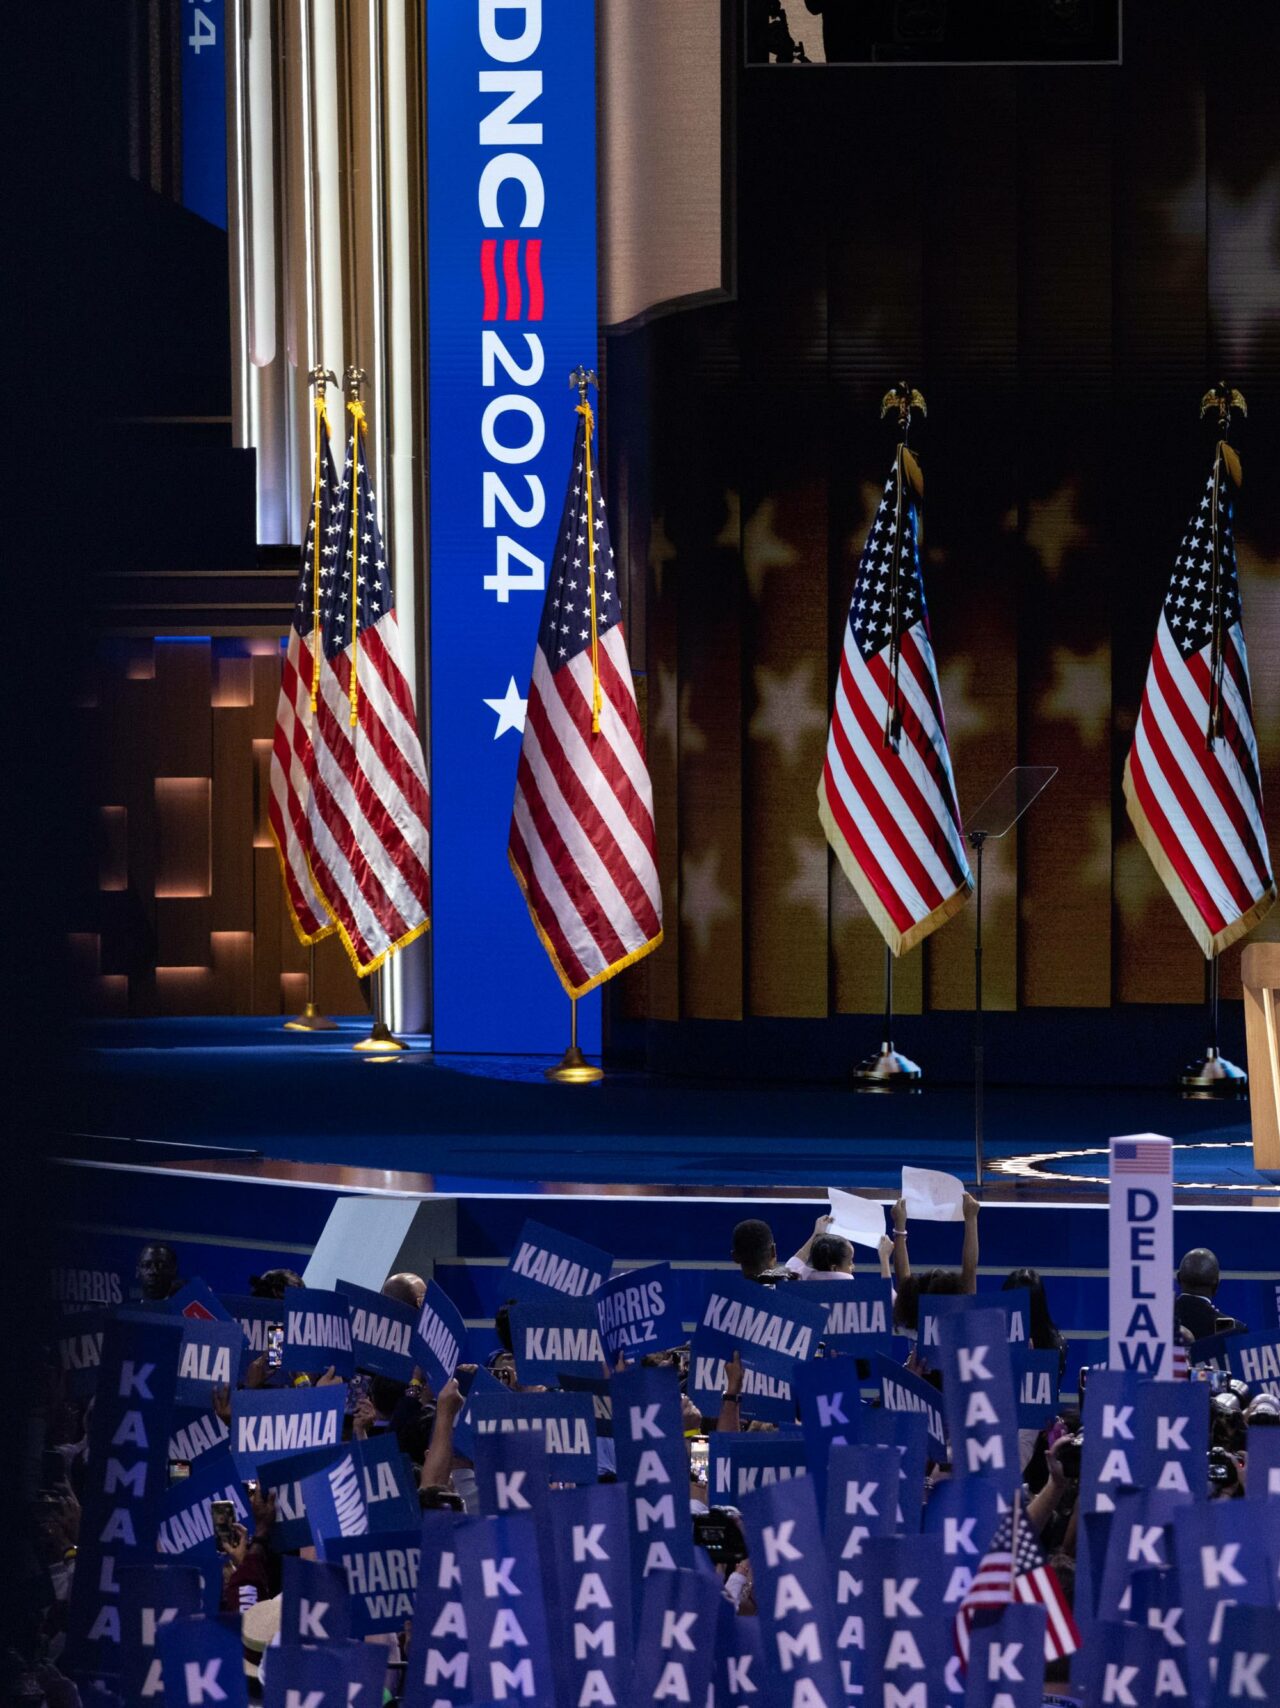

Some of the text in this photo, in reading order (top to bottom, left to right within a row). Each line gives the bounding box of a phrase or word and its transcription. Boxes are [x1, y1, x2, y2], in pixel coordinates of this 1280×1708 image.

[481, 330, 545, 603] 2024
[287, 1311, 353, 1352] KAMALA
[418, 1303, 460, 1378] KAMALA
[597, 1280, 666, 1337] HARRIS
[606, 1320, 657, 1352] WALZ
[703, 1294, 813, 1361] KAMALA
[820, 1301, 887, 1335] MALA
[1118, 1188, 1166, 1371] DELAW
[177, 1342, 231, 1383] ALA
[525, 1327, 605, 1361] KAMA
[238, 1409, 338, 1452] KAMALA
[957, 1345, 1006, 1473] KAM
[88, 1360, 156, 1643] KAMALA
[628, 1403, 677, 1578] KAMA
[365, 1594, 415, 1620] WA
[424, 1552, 469, 1708] KAM
[481, 1558, 536, 1700] KAM
[572, 1524, 617, 1708] KAMA
[761, 1519, 829, 1708] KAMA
[837, 1480, 880, 1695] KAMAL
[883, 1578, 928, 1708] KAM
